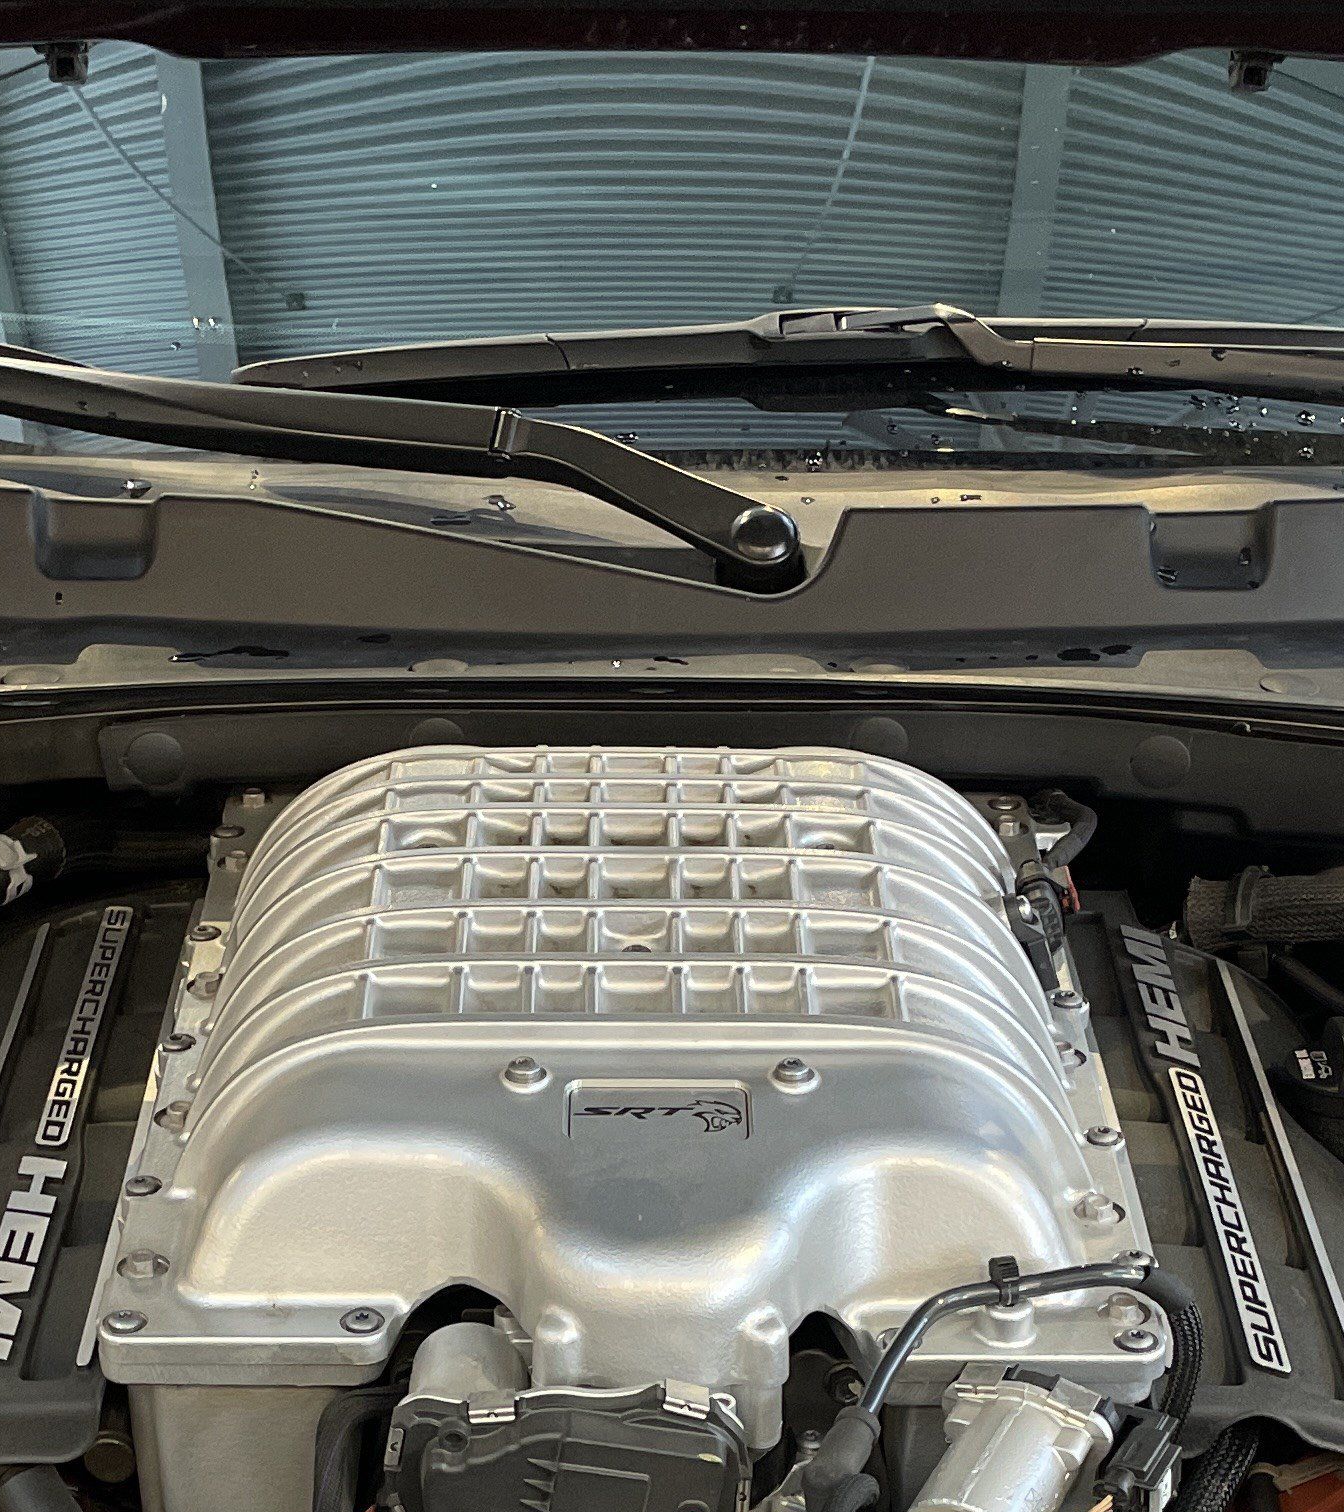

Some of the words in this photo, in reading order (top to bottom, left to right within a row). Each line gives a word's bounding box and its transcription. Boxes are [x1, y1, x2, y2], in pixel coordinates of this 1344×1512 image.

[41, 908, 128, 1142] SUPERCHARGED
[1121, 924, 1201, 1069] HEMI
[573, 1106, 696, 1120] SRT
[1175, 1070, 1285, 1368] SUPERCHARGED
